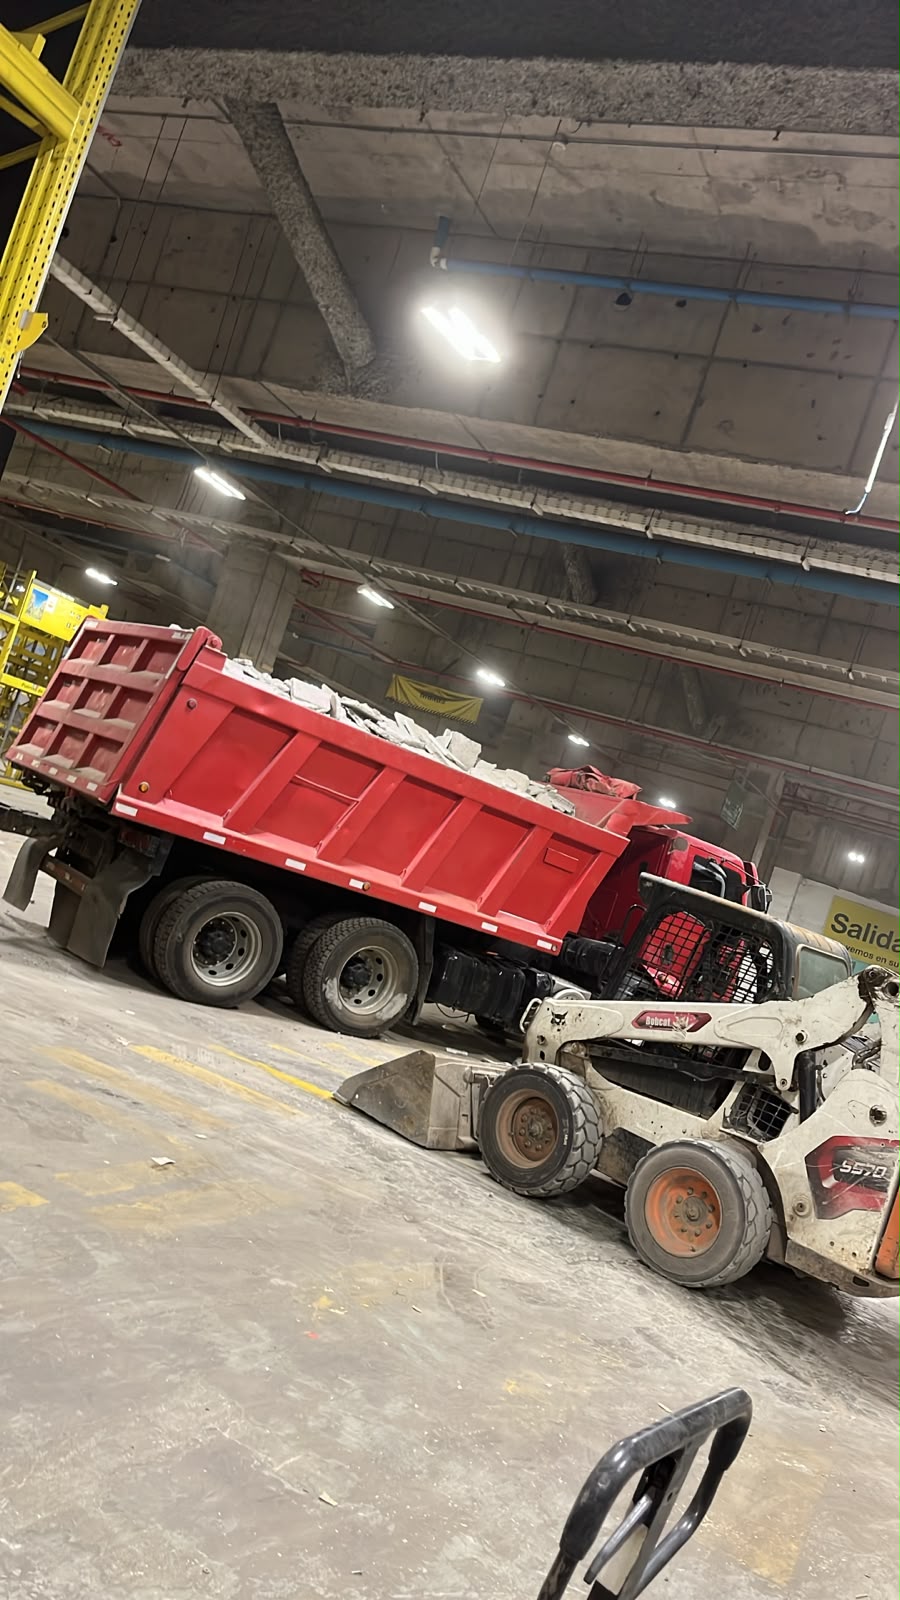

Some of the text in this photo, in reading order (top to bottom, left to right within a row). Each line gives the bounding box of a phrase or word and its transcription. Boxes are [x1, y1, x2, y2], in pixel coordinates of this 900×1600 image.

[876, 955, 887, 964] en
[889, 960, 899, 968] su
[645, 1015, 671, 1027] Bobcat
[839, 1159, 888, 1179] S570
